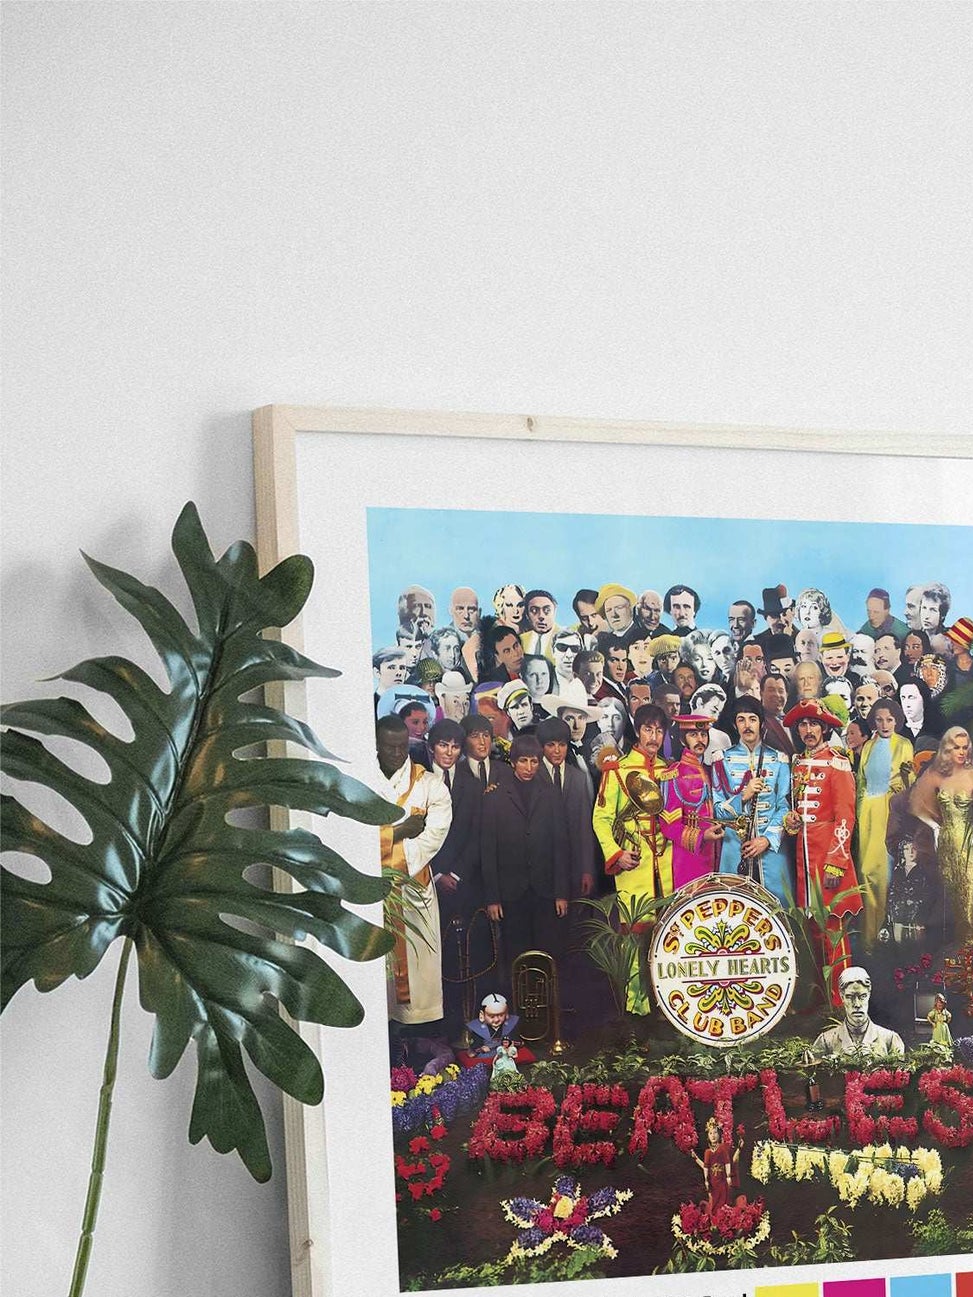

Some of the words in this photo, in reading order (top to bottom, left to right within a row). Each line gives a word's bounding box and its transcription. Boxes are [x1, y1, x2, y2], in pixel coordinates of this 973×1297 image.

[657, 959, 721, 980] LONELY
[727, 955, 791, 976] HEARTS
[667, 990, 724, 1037] CLUB
[730, 983, 783, 1036] BAND
